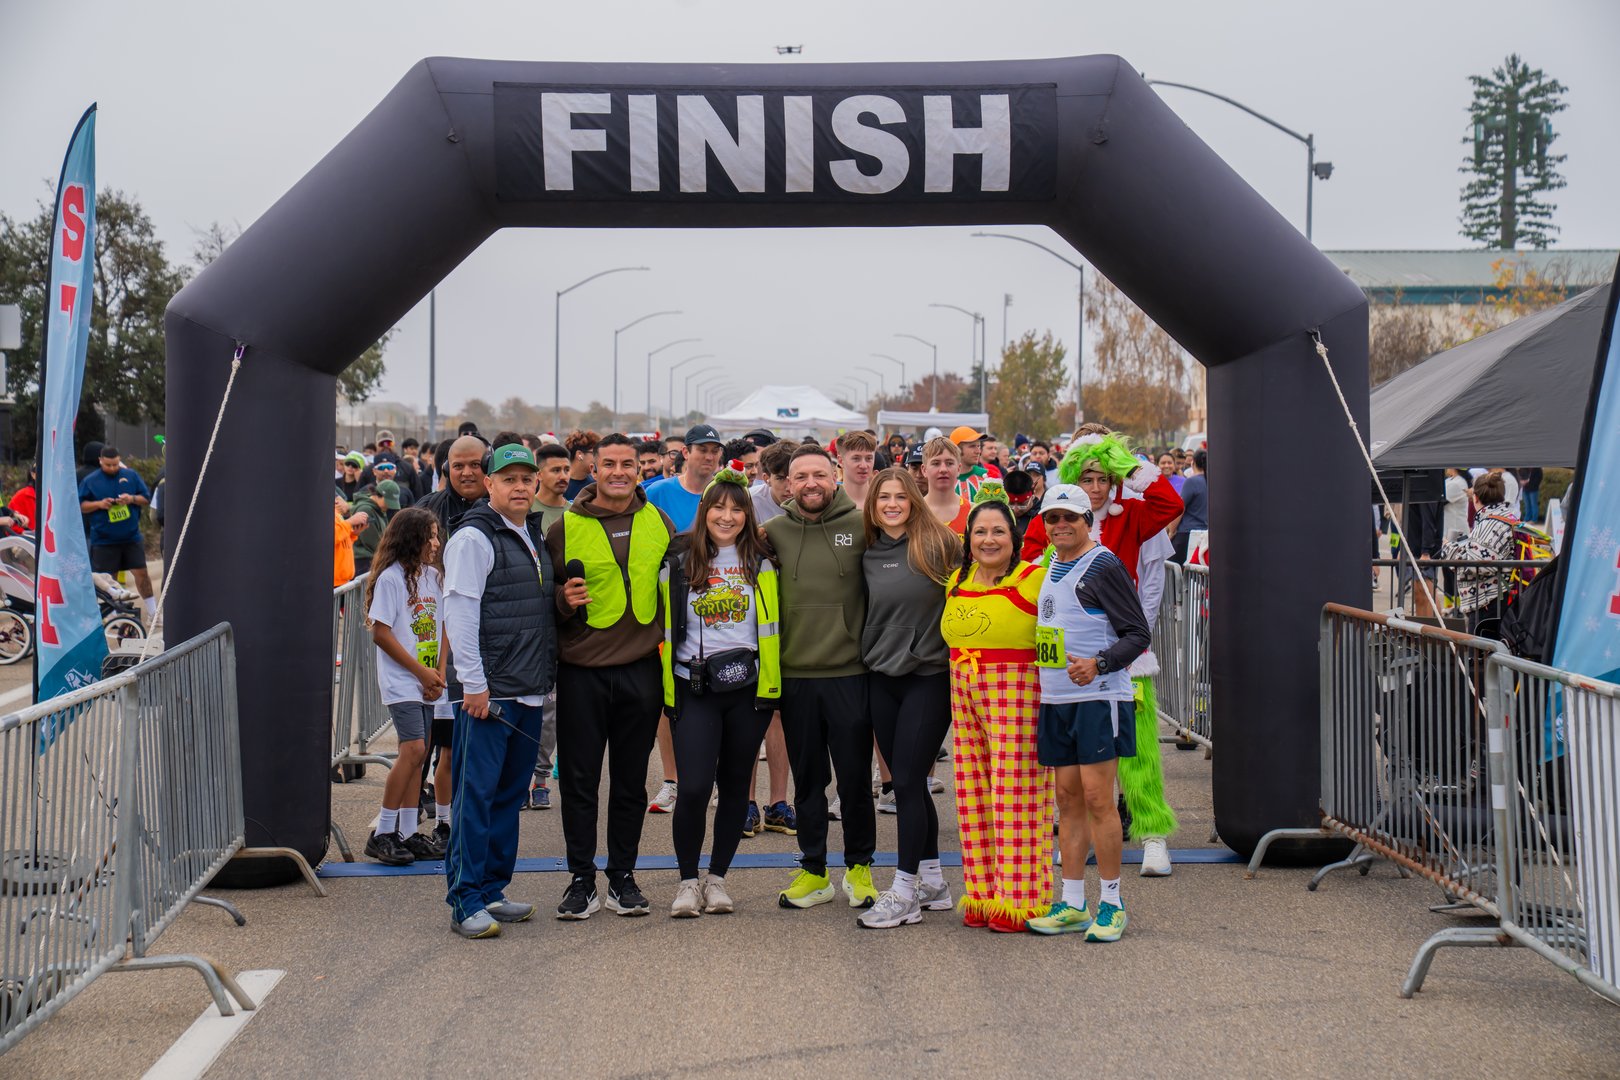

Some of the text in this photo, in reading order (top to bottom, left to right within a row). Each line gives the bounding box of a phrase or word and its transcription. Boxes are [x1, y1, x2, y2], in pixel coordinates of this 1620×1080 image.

[540, 92, 1010, 194] FINISH
[111, 510, 127, 520] 309
[694, 594, 749, 616] GRINCH
[1037, 642, 1058, 664] 184
